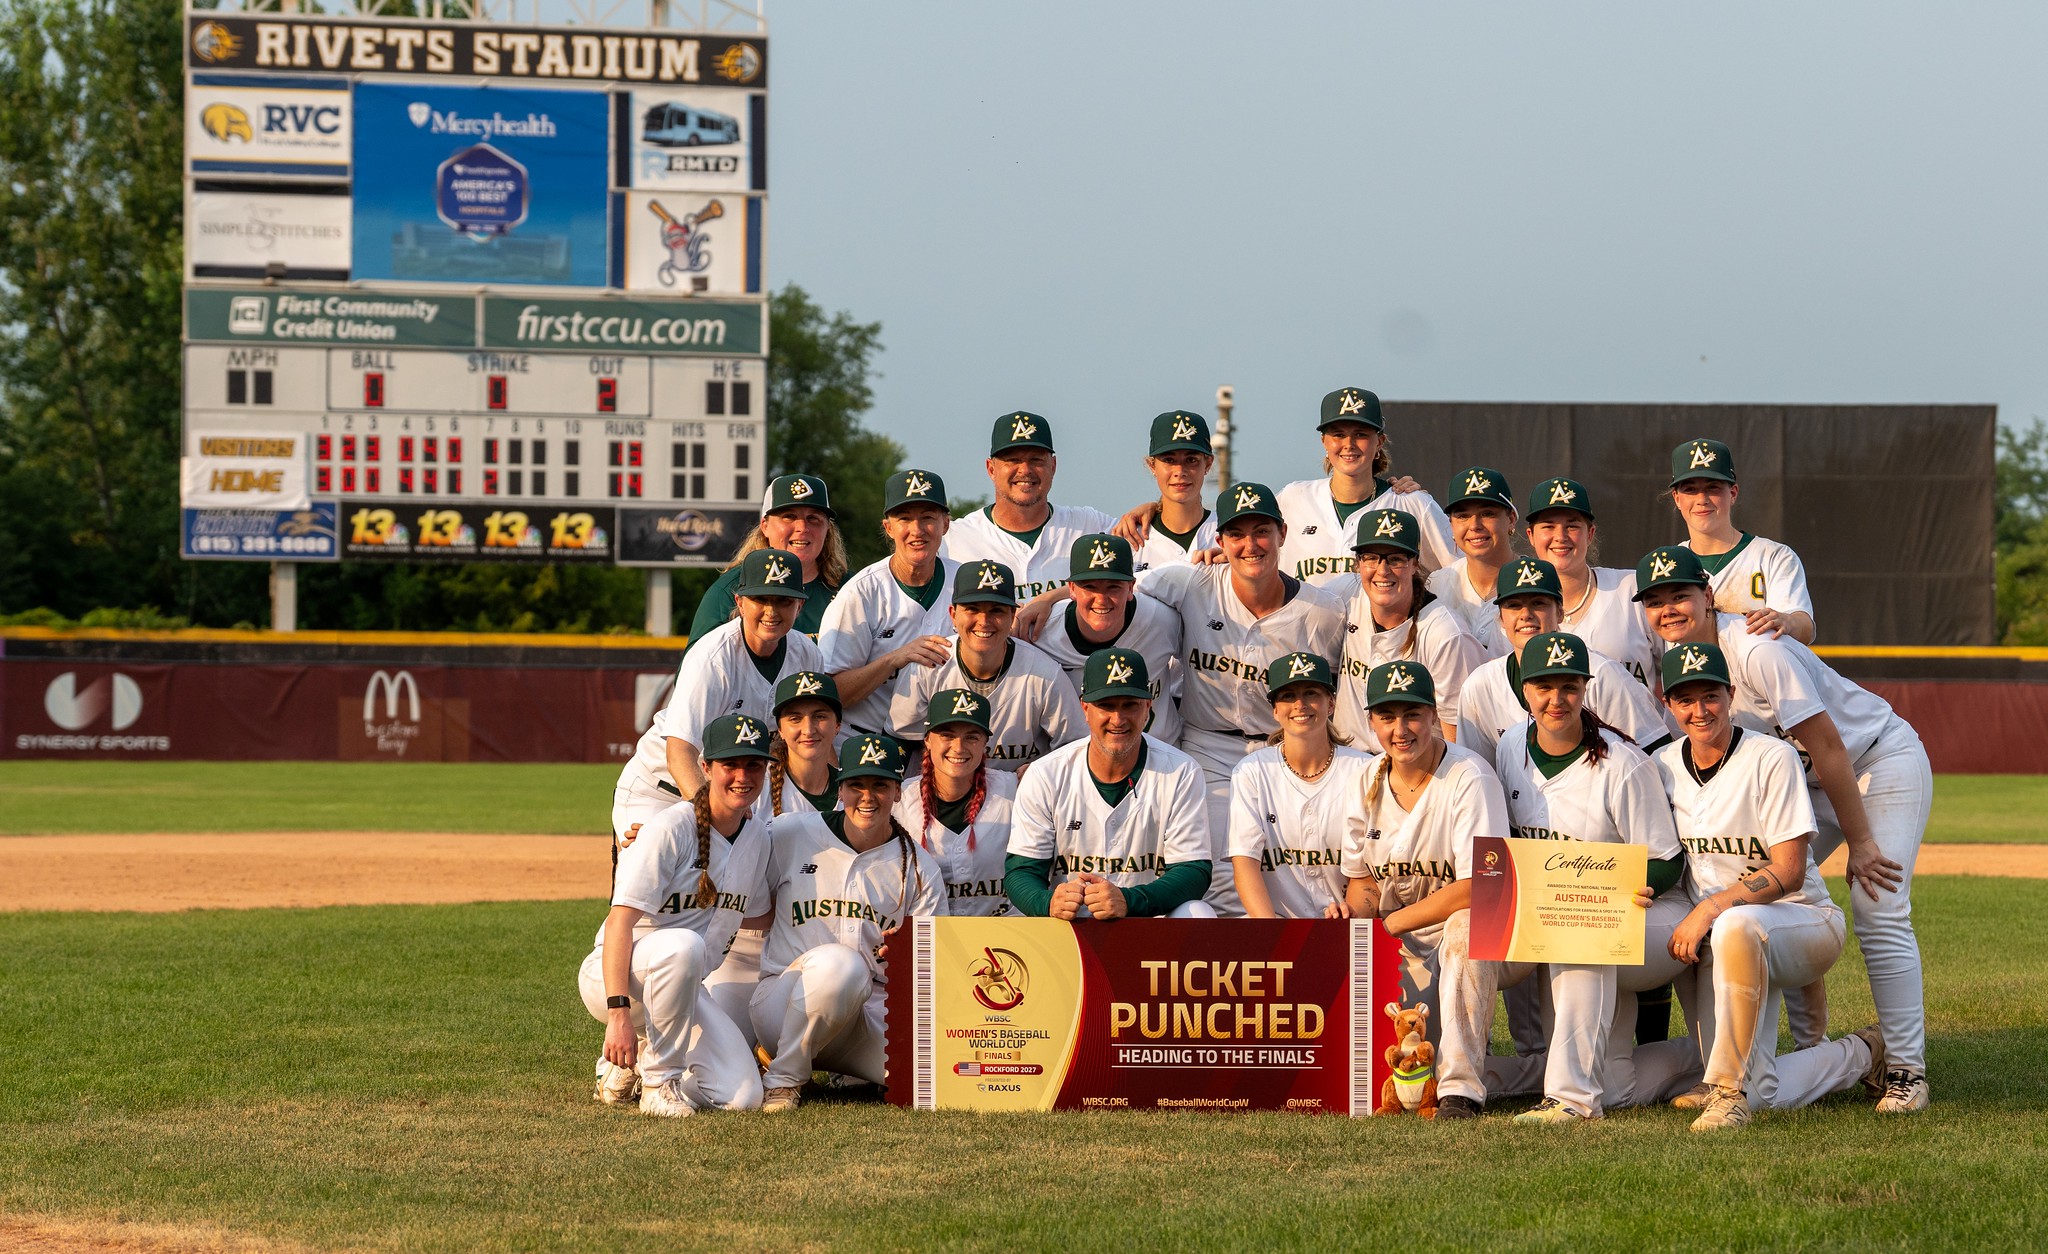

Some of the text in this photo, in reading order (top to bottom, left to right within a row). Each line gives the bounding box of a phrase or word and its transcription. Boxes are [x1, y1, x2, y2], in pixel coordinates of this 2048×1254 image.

[256, 23, 699, 81] RIVETS STADIUM
[264, 104, 340, 134] RVC
[431, 111, 557, 140] Mercyhealth
[671, 156, 736, 171] RMTD
[451, 179, 515, 192] AMERICA'S
[456, 191, 508, 203] 100 BEST
[201, 222, 342, 238] SIMPLE STITCHES
[276, 296, 439, 322] First Community
[273, 318, 396, 339] Credit Union
[517, 305, 726, 345] firstccu.com
[227, 351, 278, 366] MPH
[351, 352, 624, 376] BALL STRIKE OUT
[713, 361, 741, 378] H/E
[364, 373, 384, 407] 0
[488, 375, 507, 410] 0
[598, 378, 616, 412] 2
[321, 415, 329, 429] 1
[345, 416, 353, 430] 2
[369, 416, 377, 430] 3
[402, 417, 411, 431] 4
[426, 417, 435, 431] 5
[450, 418, 459, 432] 6
[486, 419, 494, 433] 7
[536, 420, 545, 434] 9
[565, 420, 581, 434] 10
[605, 421, 646, 437] RUNS
[672, 422, 705, 438] HITS
[728, 424, 756, 439] ERR
[200, 437, 295, 458] VISITORS
[318, 435, 331, 460] 3
[342, 435, 355, 460] 2
[366, 436, 380, 461] 3
[400, 436, 413, 462] 0
[424, 437, 437, 462] 4
[448, 437, 461, 462] 0
[210, 470, 284, 492] HOME
[318, 467, 331, 491] 3
[341, 467, 355, 492] 0
[366, 467, 379, 492] 0
[400, 468, 413, 493] 4
[423, 469, 437, 493] 4
[484, 469, 498, 494] 2
[351, 508, 396, 545] 13
[417, 510, 462, 546] 13
[484, 511, 529, 547] 13
[550, 512, 595, 548] 13
[17, 734, 171, 751] SYNERGY SPORTS
[1052, 852, 1166, 877] AUSTRALIA
[1544, 852, 1619, 878] Certificate
[1554, 893, 1609, 904] AUSTRALIA
[1591, 915, 1622, 923] BASEBALL
[1141, 960, 1293, 996] TICKET
[985, 1015, 1011, 1023] WBSC
[1111, 1003, 1325, 1038] PUNCHED
[946, 1029, 1050, 1039] WOMEN'S BASEBALL
[969, 1039, 1027, 1049] WORLD CUP
[984, 1052, 1012, 1060] FINALS
[1119, 1049, 1315, 1065] HEADING TO THE FINALS
[1082, 1097, 1129, 1107] WBSC.ORG
[1157, 1098, 1249, 1109] #BaseballWorldCupW
[1286, 1098, 1322, 1109] @WBSC
